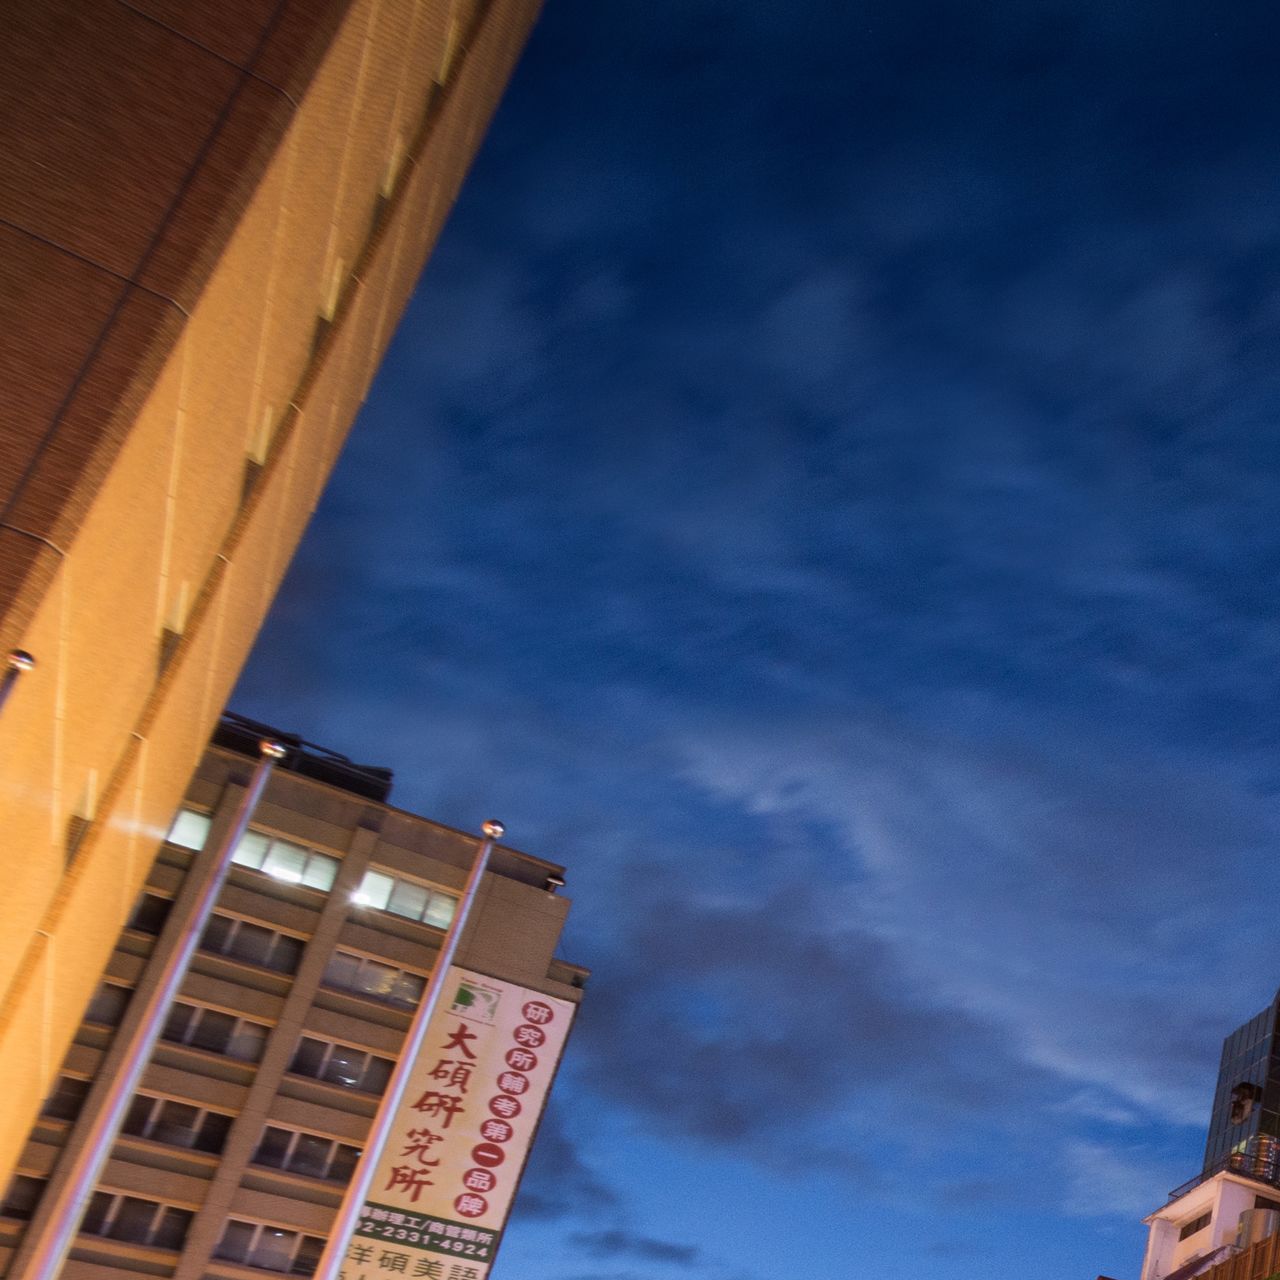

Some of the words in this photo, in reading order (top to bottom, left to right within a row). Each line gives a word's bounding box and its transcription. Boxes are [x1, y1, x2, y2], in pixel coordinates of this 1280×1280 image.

[385, 1023, 477, 1202] 大碩研究所
[456, 1002, 551, 1215] 研究所輔考第一品牌
